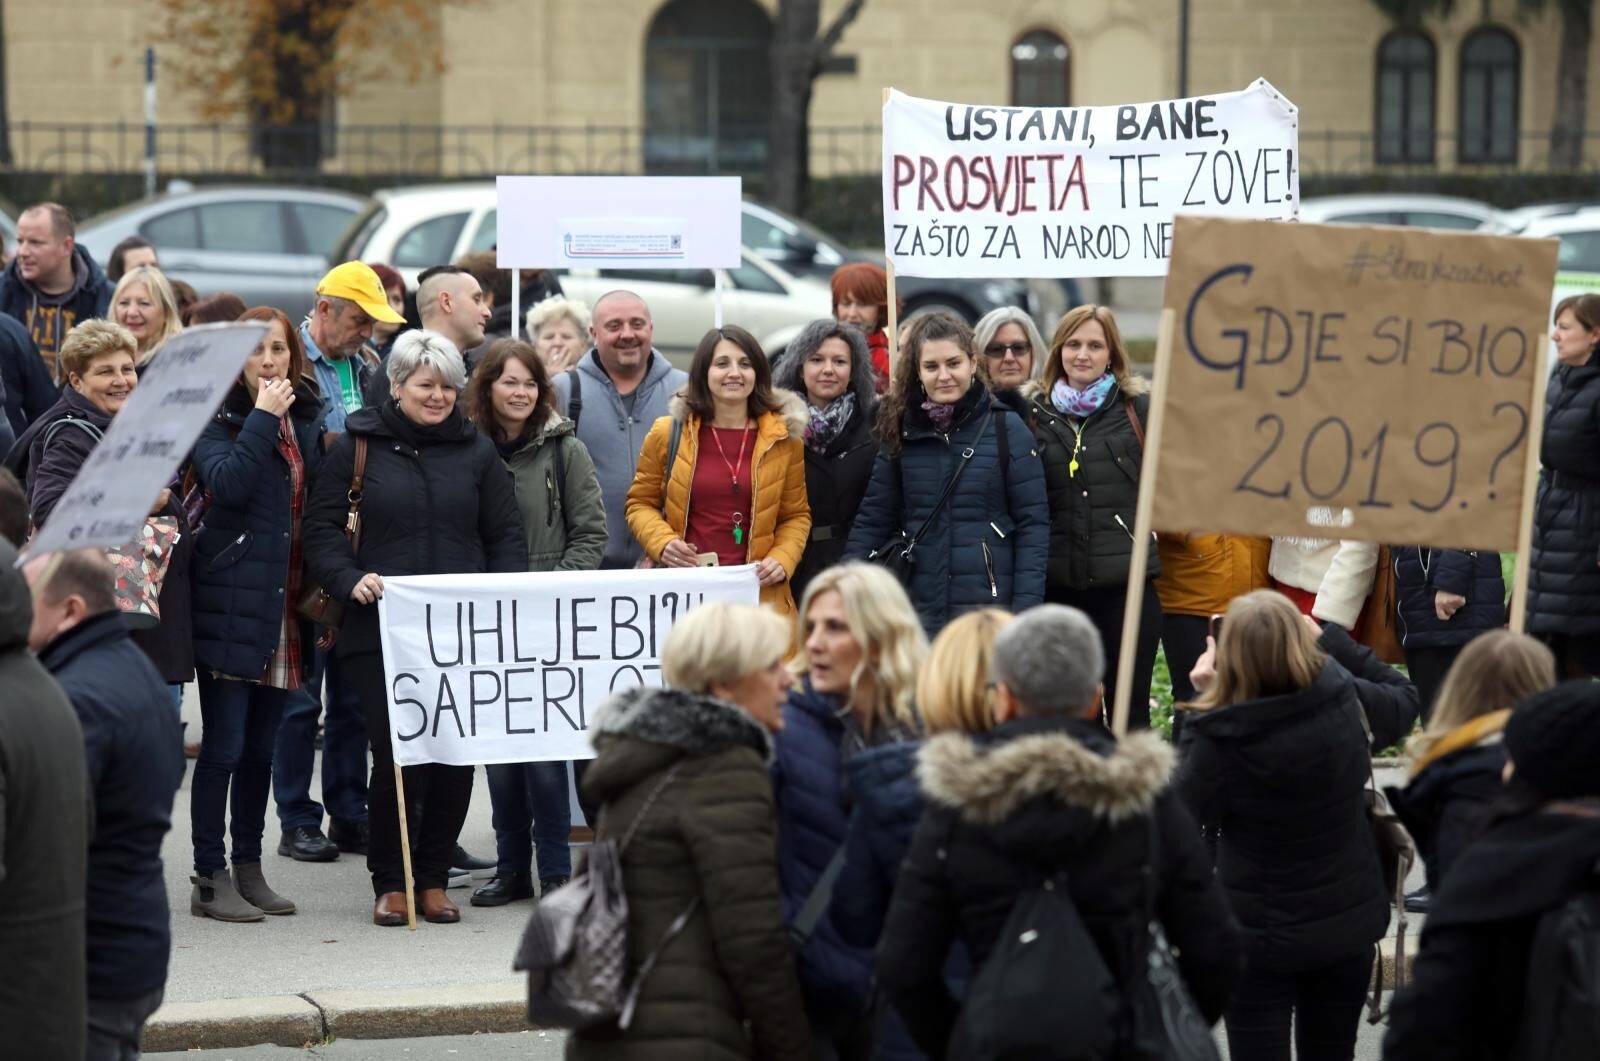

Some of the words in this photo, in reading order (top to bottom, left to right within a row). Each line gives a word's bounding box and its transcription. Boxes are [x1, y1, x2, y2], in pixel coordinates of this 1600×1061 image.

[945, 105, 1095, 148] USTANI,
[1116, 100, 1230, 145] BANE,
[893, 154, 1090, 216] PROSVJETA
[1109, 154, 1159, 208] TE
[1182, 148, 1294, 206] ZOVE!
[893, 219, 970, 258] ZAŠTO
[980, 224, 1021, 259] ZA
[1042, 224, 1131, 259] NAROD
[1185, 264, 1346, 397] GDJE
[1365, 315, 1413, 364] SI
[1428, 318, 1528, 378] BIO
